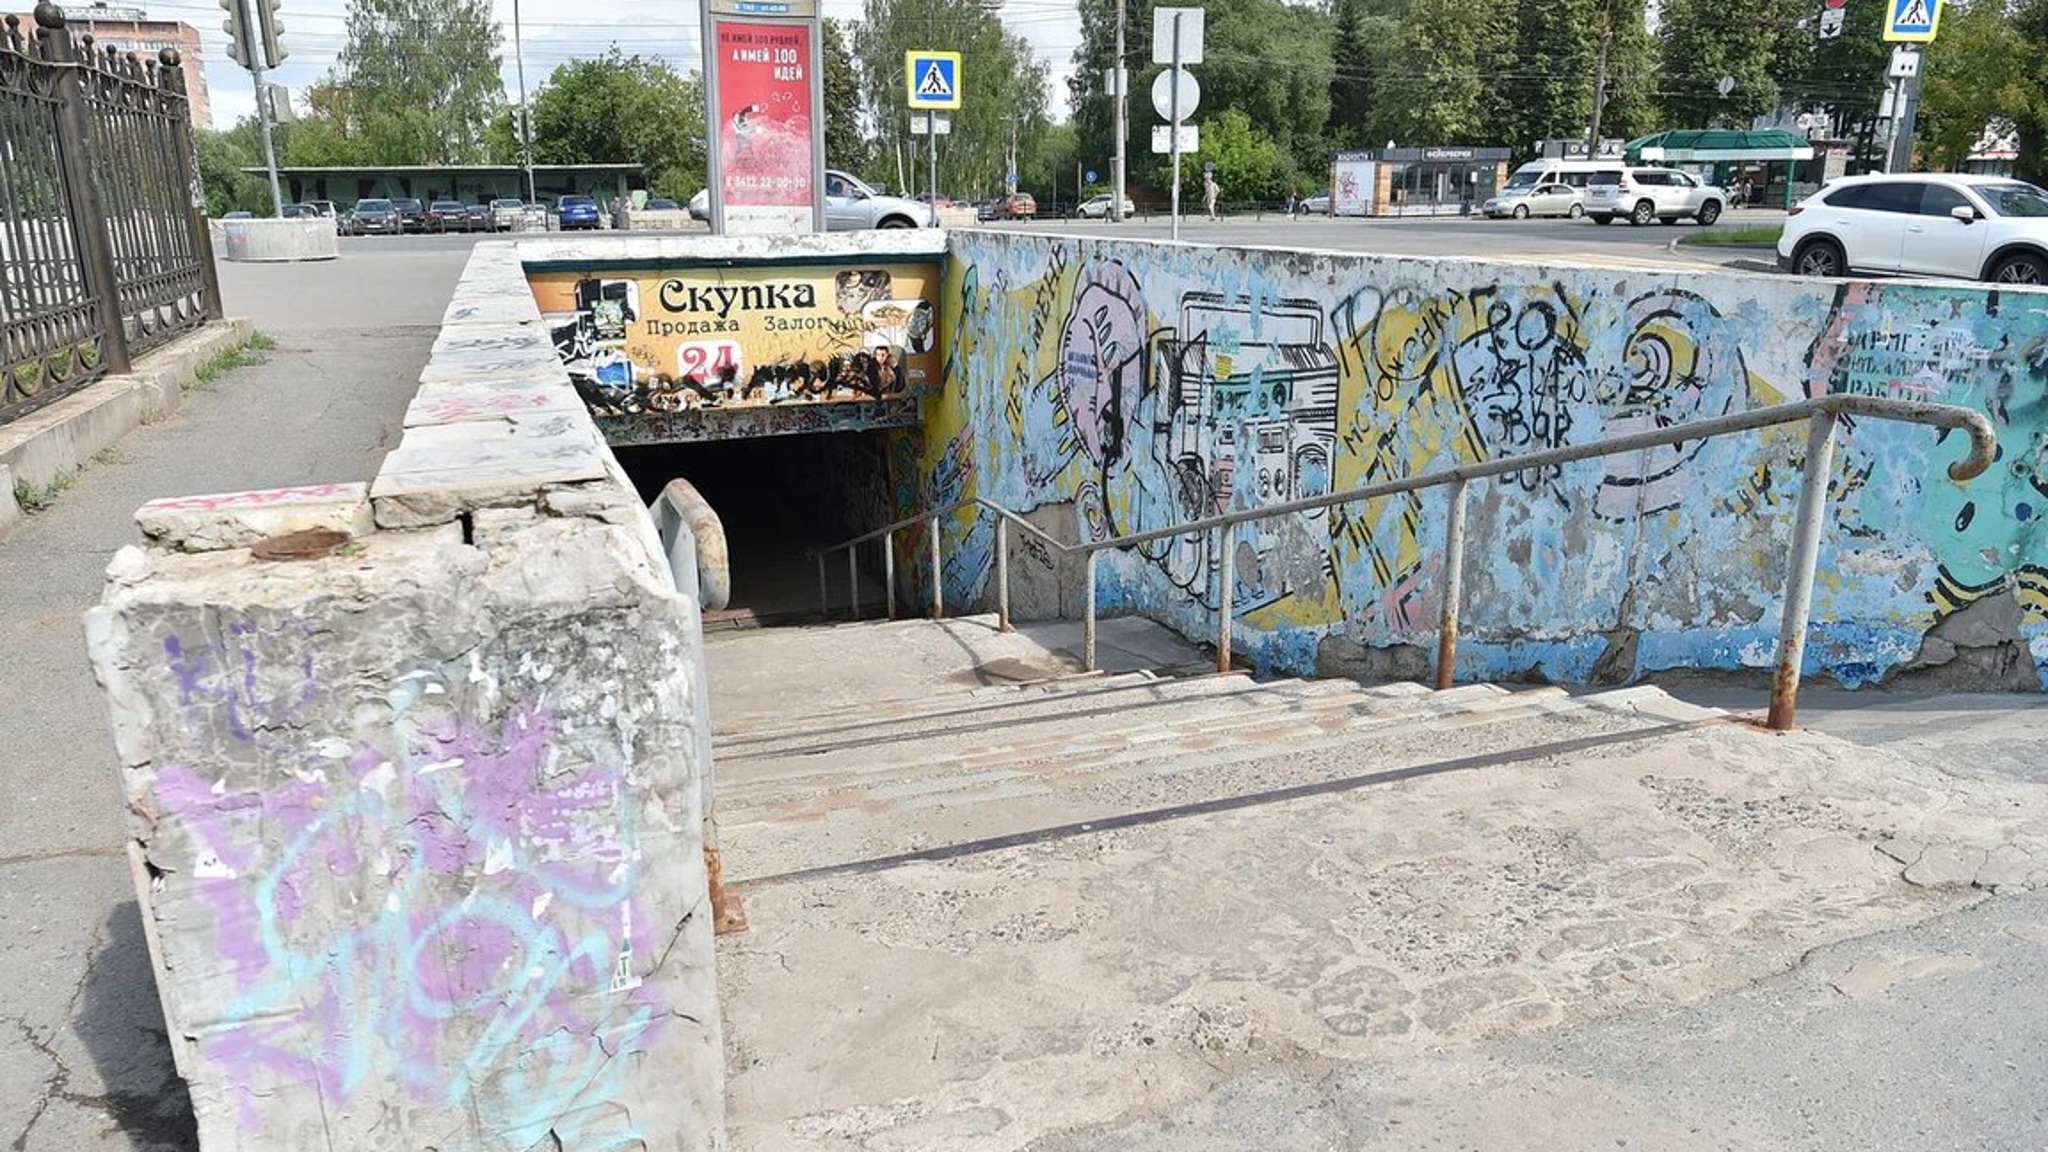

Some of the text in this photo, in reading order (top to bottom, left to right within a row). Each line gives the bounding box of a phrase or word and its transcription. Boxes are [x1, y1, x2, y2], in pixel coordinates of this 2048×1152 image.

[732, 48, 797, 63] А ИМЕЙ 100
[774, 64, 803, 81] ИДЕЙ
[659, 279, 816, 318] Скупка
[646, 318, 740, 337] Продажа
[682, 345, 739, 387] 24
